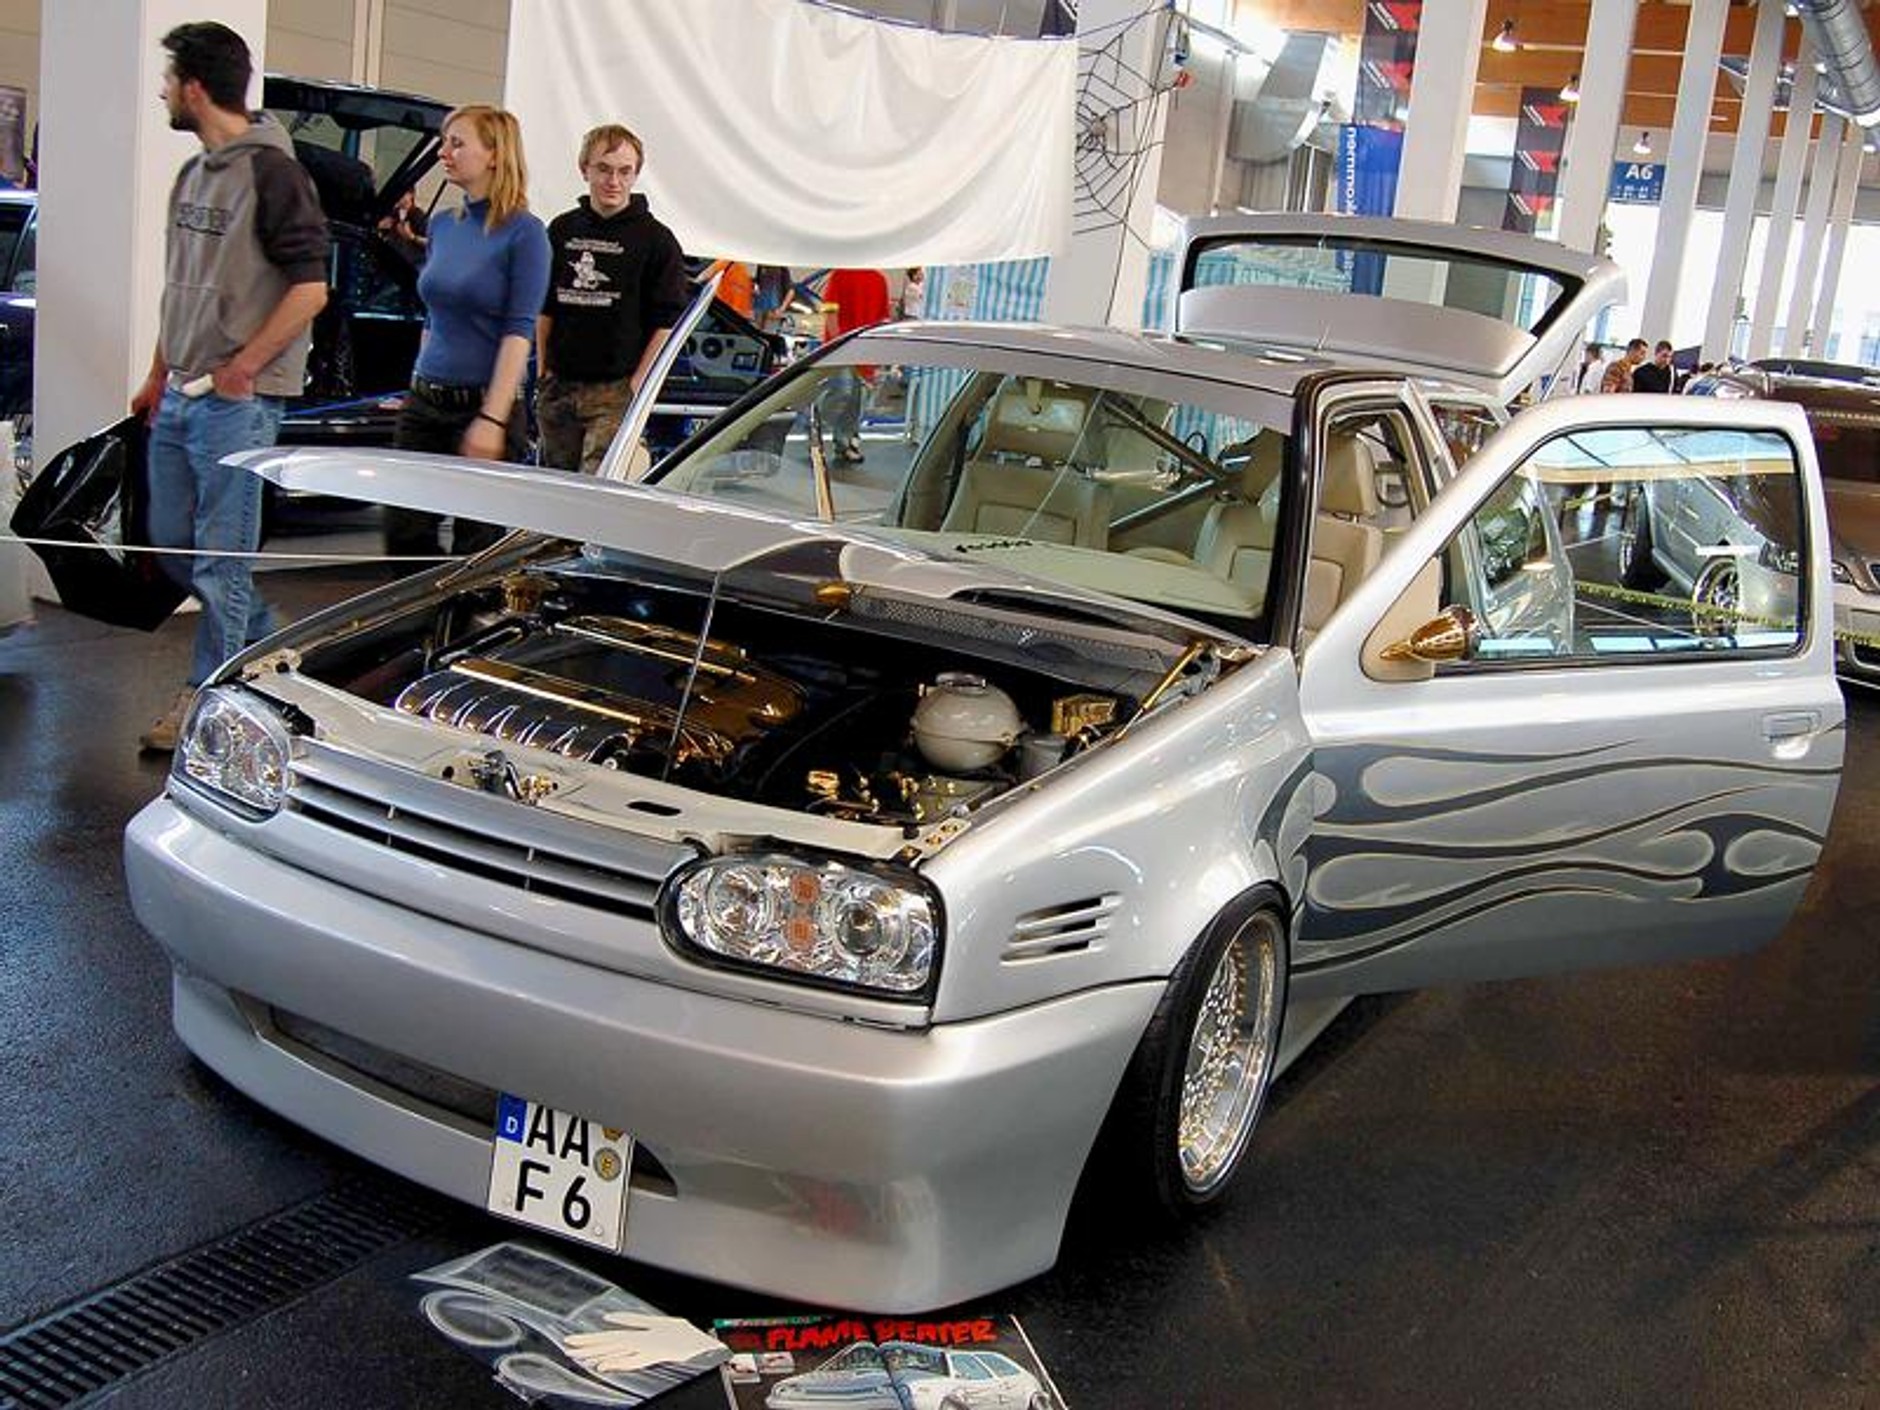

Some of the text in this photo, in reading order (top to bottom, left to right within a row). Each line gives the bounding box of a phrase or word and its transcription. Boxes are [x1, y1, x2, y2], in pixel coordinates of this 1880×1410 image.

[1625, 164, 1654, 180] A6
[505, 1115, 518, 1135] D
[526, 1104, 590, 1167] AA
[514, 1159, 591, 1230] F 6
